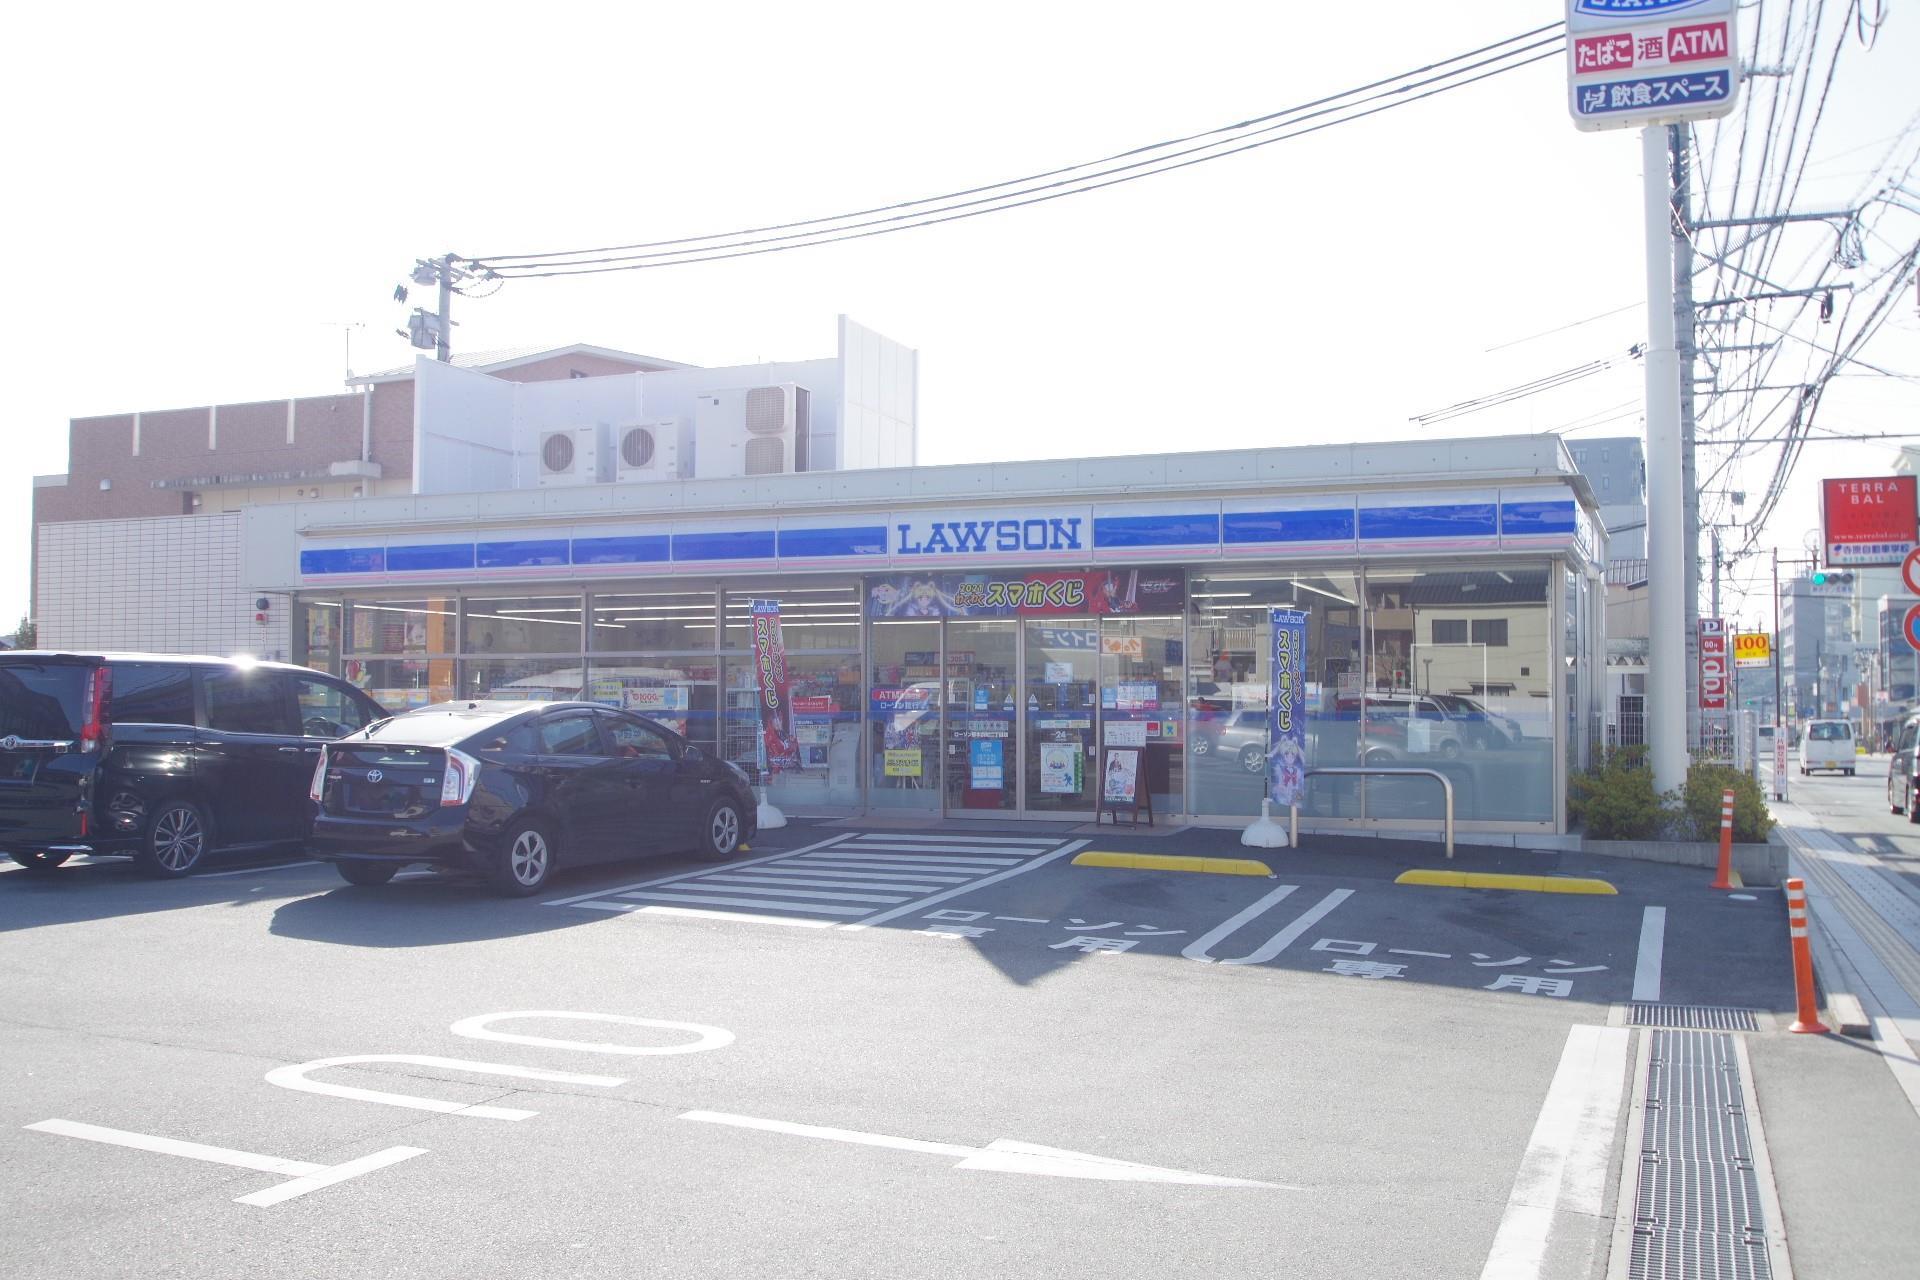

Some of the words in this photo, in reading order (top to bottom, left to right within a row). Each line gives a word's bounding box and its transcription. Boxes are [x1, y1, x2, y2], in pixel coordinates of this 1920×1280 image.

[1578, 40, 1632, 68] たばこ
[1637, 36, 1664, 61] 酒
[1670, 28, 1725, 57] ATM
[1611, 76, 1725, 108] 飲食スペース
[1838, 482, 1899, 494] TERRA
[1850, 494, 1885, 505] BAL
[897, 517, 1082, 555] LAWSON
[959, 583, 983, 593] 2021
[985, 579, 1084, 607] スマホくじ
[752, 604, 780, 613] LAWSON
[1273, 613, 1305, 624] LAWSON
[1704, 621, 1719, 635] P
[1735, 636, 1767, 650] 100
[756, 617, 779, 709] スマホくじ
[879, 690, 901, 700] ATM
[1277, 629, 1293, 732] スマホくじ
[922, 908, 1186, 937] ローソン
[911, 923, 1140, 955] 専用
[1310, 937, 1609, 974] ローソン
[1324, 958, 1574, 997] 専用
[24, 1009, 736, 1208] OUT
